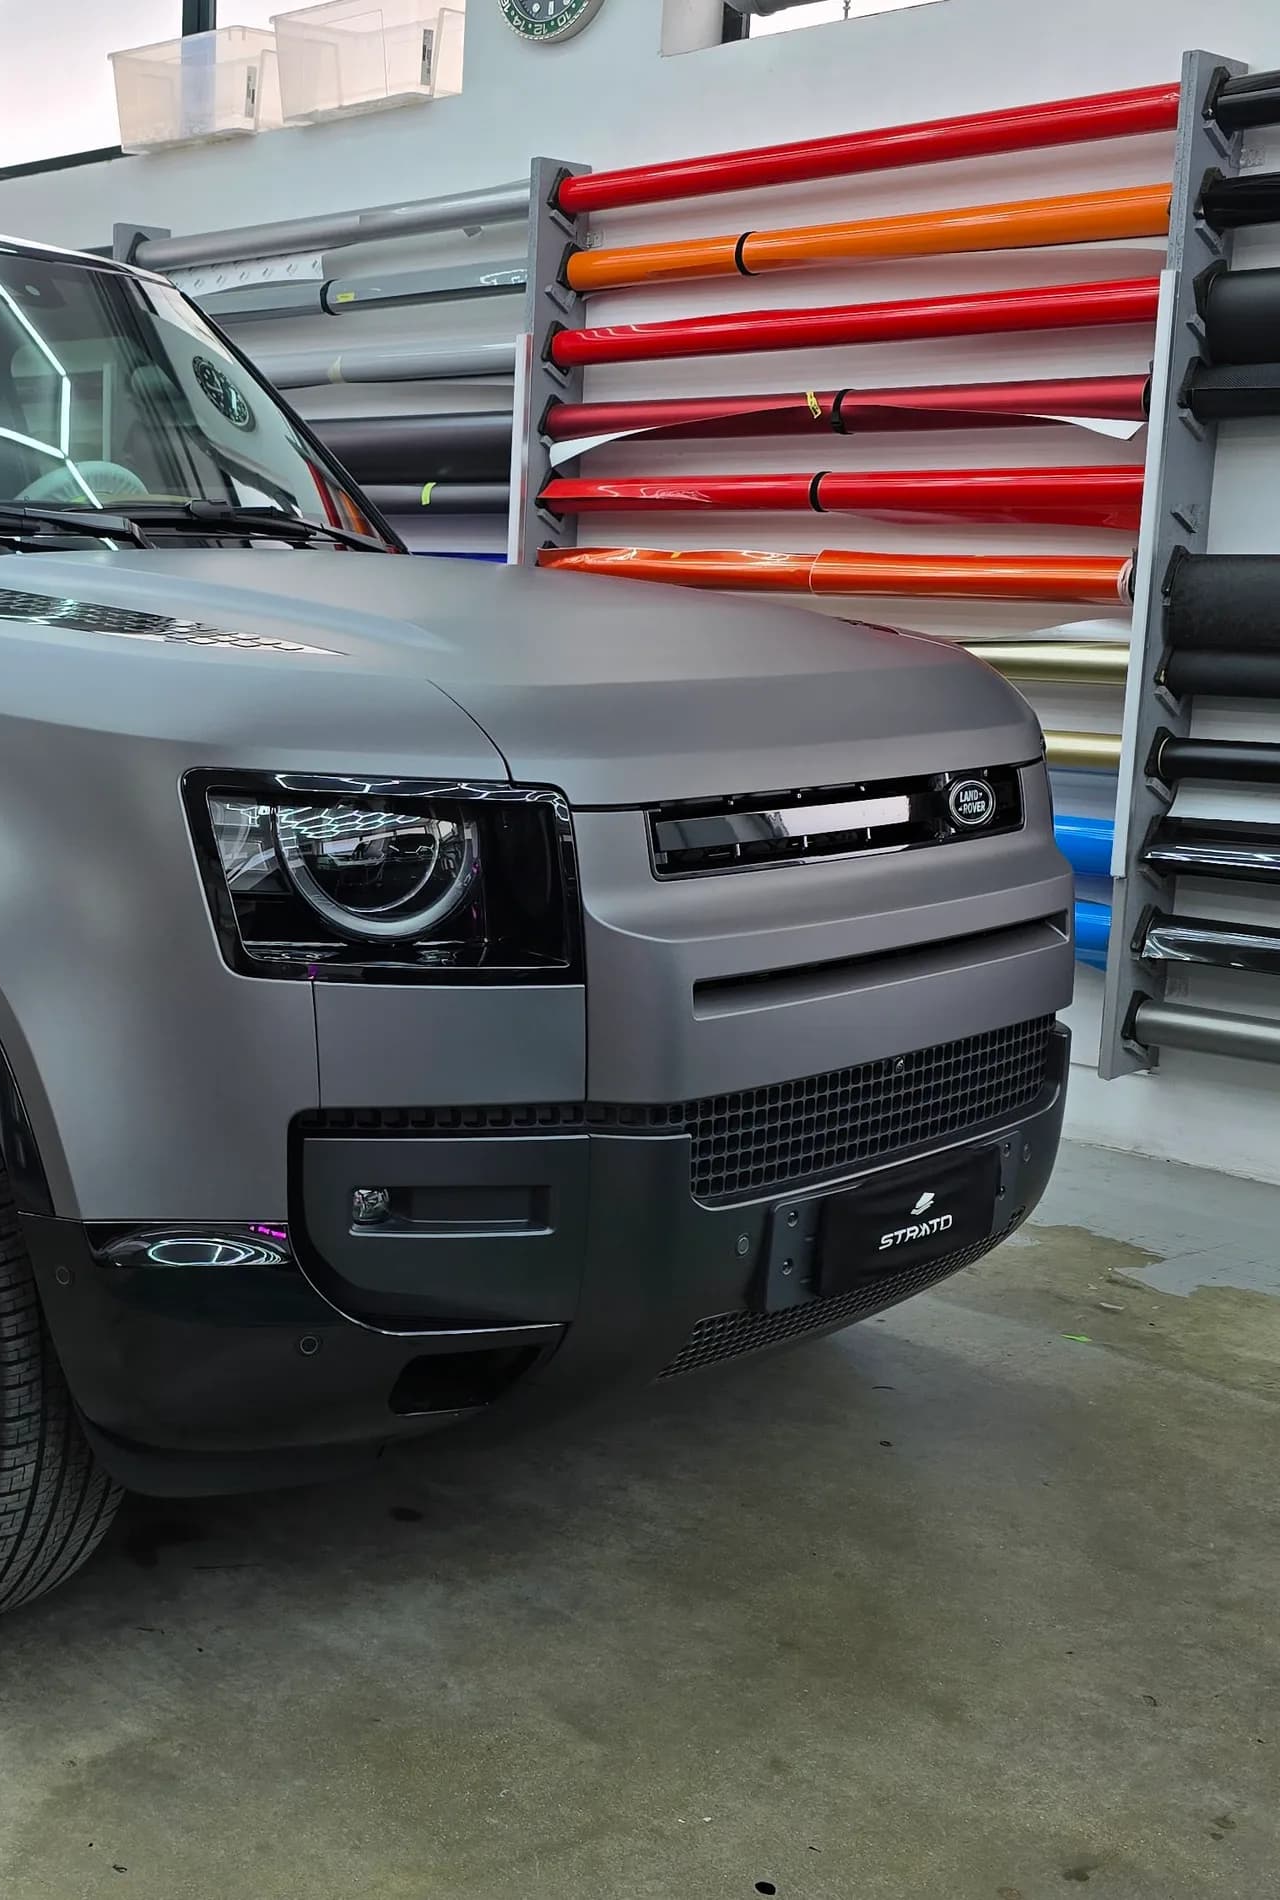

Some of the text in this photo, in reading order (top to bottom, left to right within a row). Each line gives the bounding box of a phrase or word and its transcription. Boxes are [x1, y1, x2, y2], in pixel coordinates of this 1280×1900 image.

[513, 15, 525, 31] 14
[557, 11, 571, 26] 10
[534, 24, 548, 35] 12
[960, 790, 979, 803] LAND
[962, 801, 986, 814] ROVER
[878, 1214, 953, 1250] STRATO
